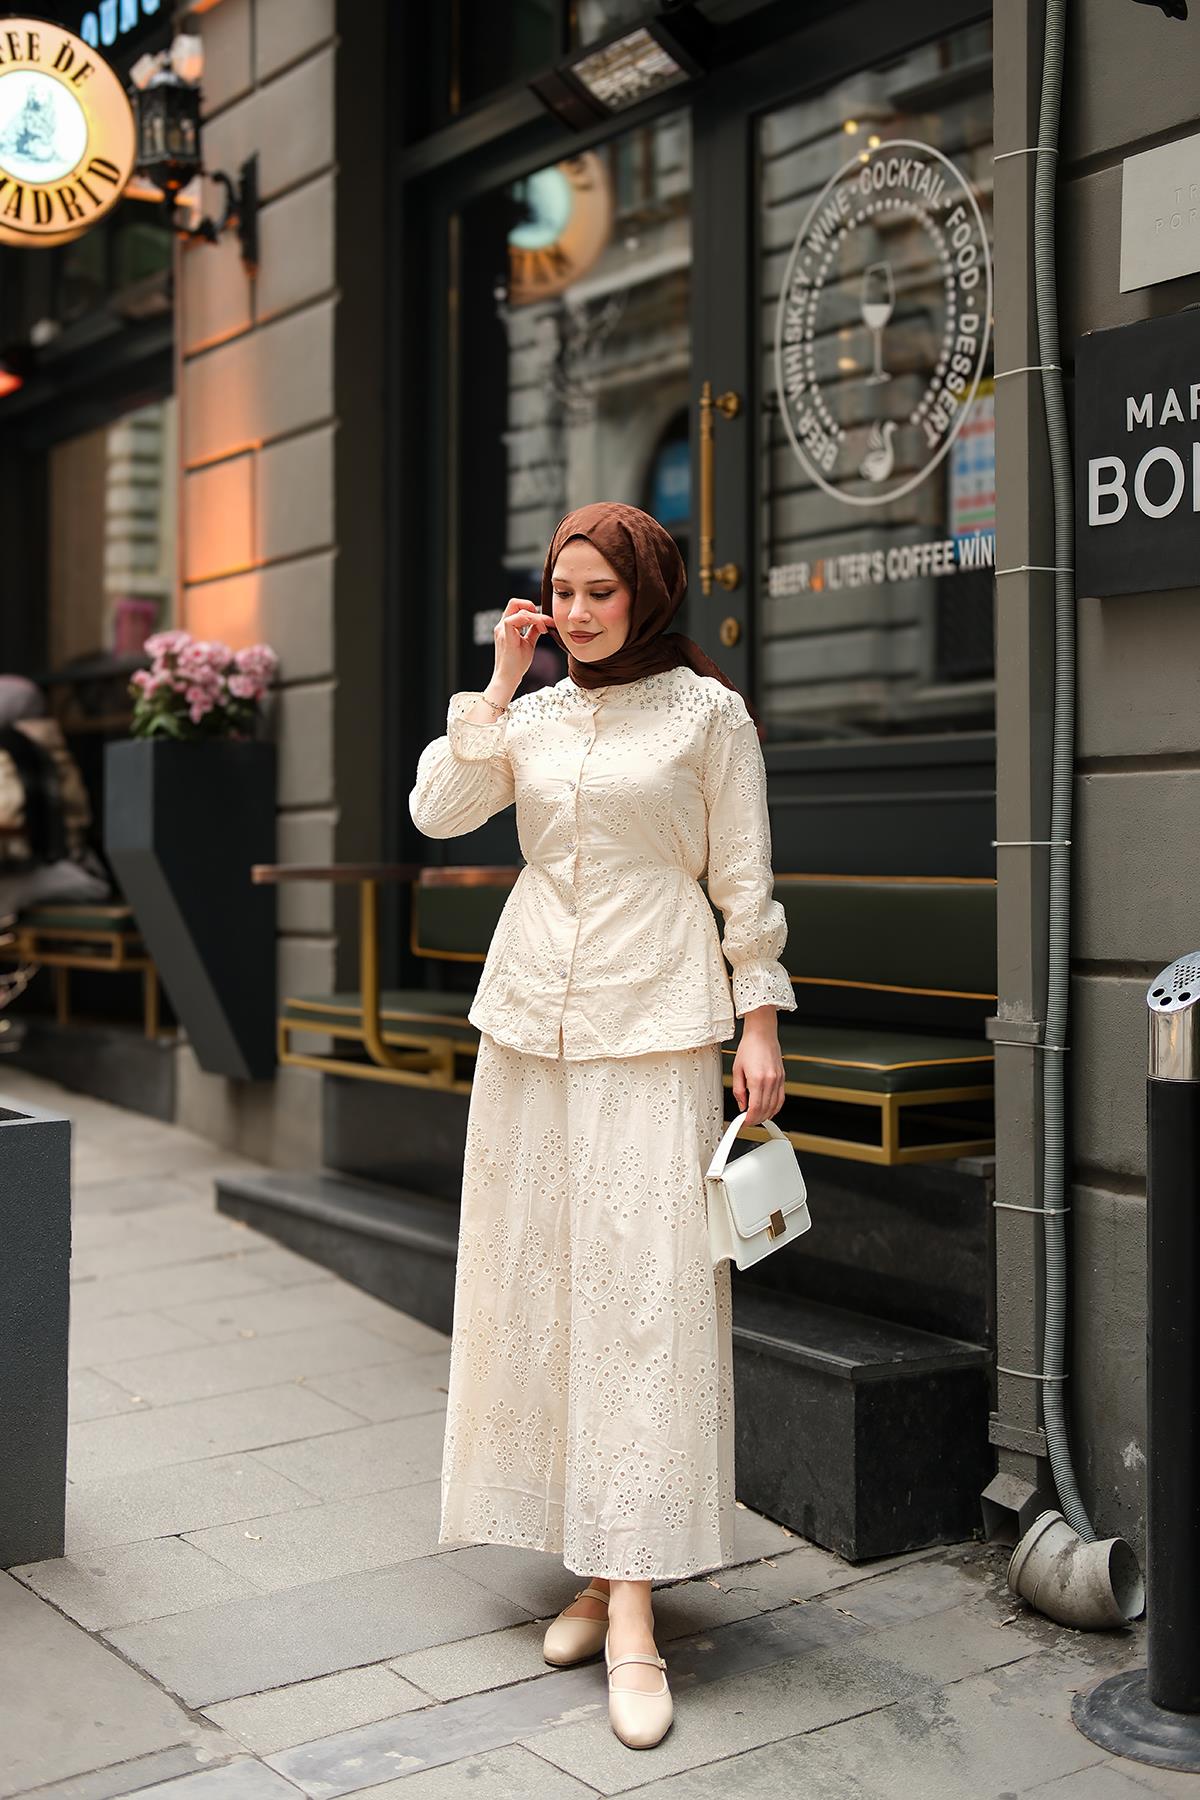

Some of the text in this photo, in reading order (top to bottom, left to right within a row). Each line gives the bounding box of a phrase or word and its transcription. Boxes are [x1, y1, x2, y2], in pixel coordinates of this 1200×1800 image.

[806, 187, 851, 253] WINE
[858, 157, 945, 211] COCKTAIL
[945, 205, 980, 290] FOOD
[783, 266, 812, 400] WHISKEY
[922, 313, 980, 450] DESSERT
[798, 407, 839, 472] BEER
[1088, 441, 1200, 527] BO
[768, 560, 808, 599] BEER
[886, 538, 955, 582] COFFEE
